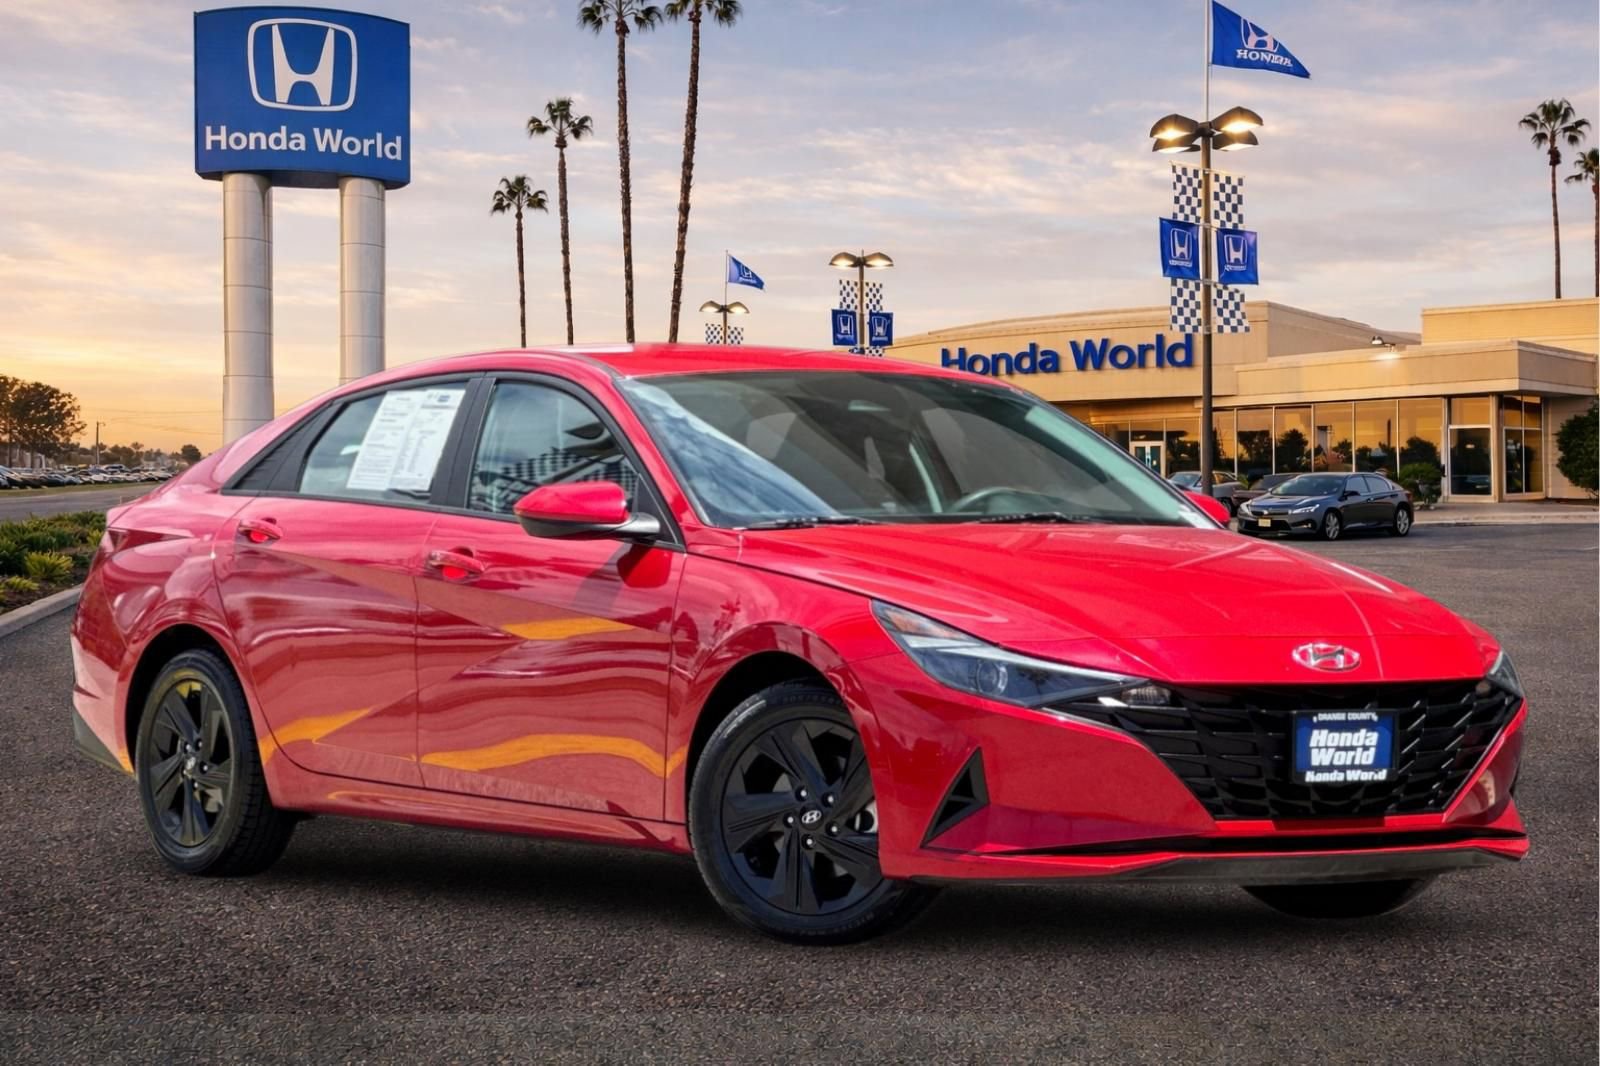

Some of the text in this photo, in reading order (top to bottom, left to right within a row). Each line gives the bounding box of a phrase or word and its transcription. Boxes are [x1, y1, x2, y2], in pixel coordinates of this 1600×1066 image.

[205, 125, 402, 160] Honda World
[941, 333, 1194, 376] Honda World
[1318, 712, 1346, 721] ORANGE
[1309, 729, 1379, 747] Honda
[1311, 747, 1376, 766] World
[1305, 770, 1345, 782] Honda
